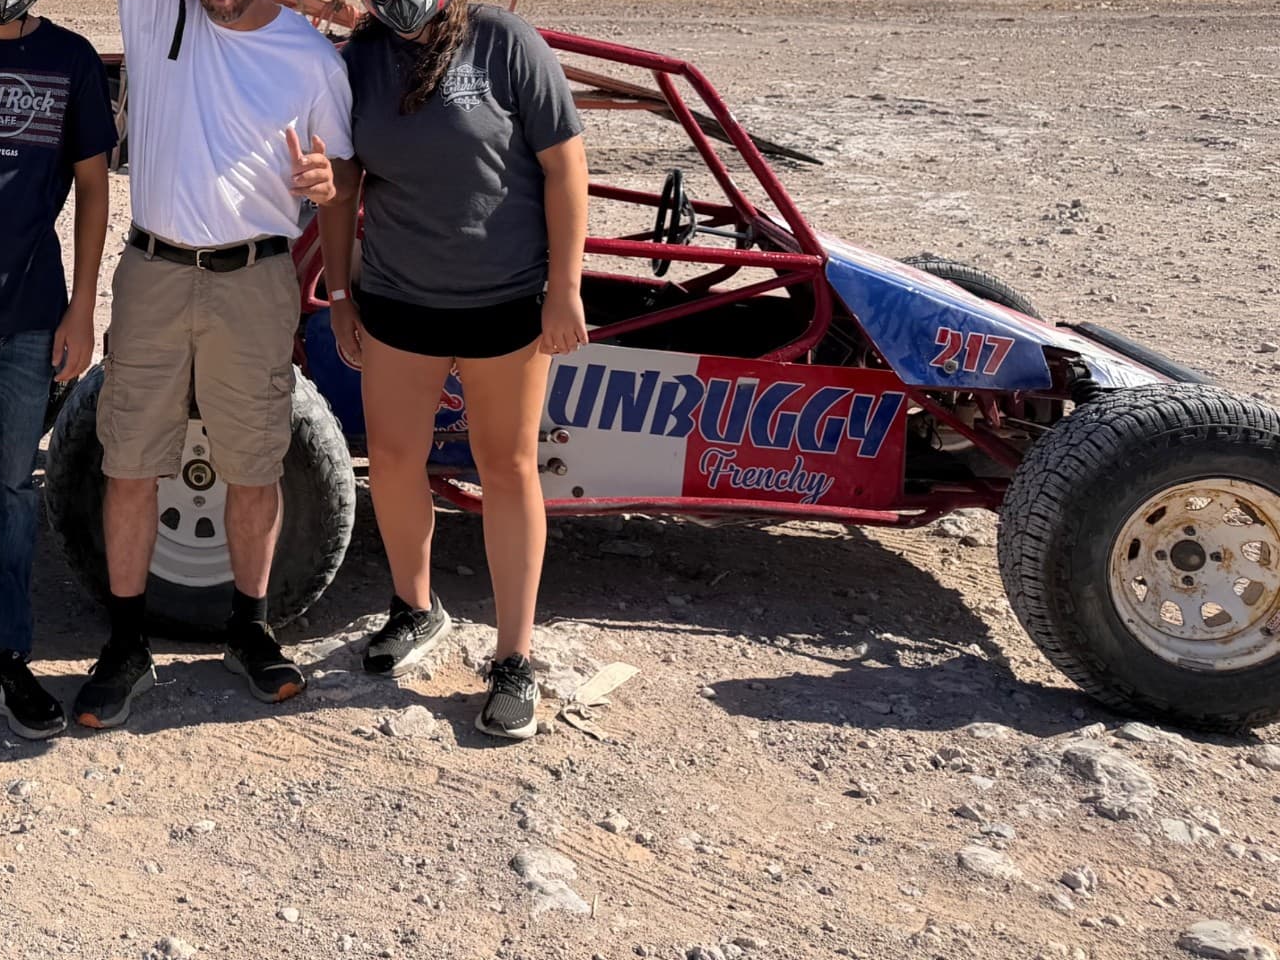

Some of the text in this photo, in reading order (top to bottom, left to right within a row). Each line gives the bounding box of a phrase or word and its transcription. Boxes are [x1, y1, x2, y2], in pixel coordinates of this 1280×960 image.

[6, 87, 56, 116] Rock
[929, 326, 1016, 376] 217
[546, 361, 907, 458] UNBUGGY
[698, 448, 835, 505] Frenchy
